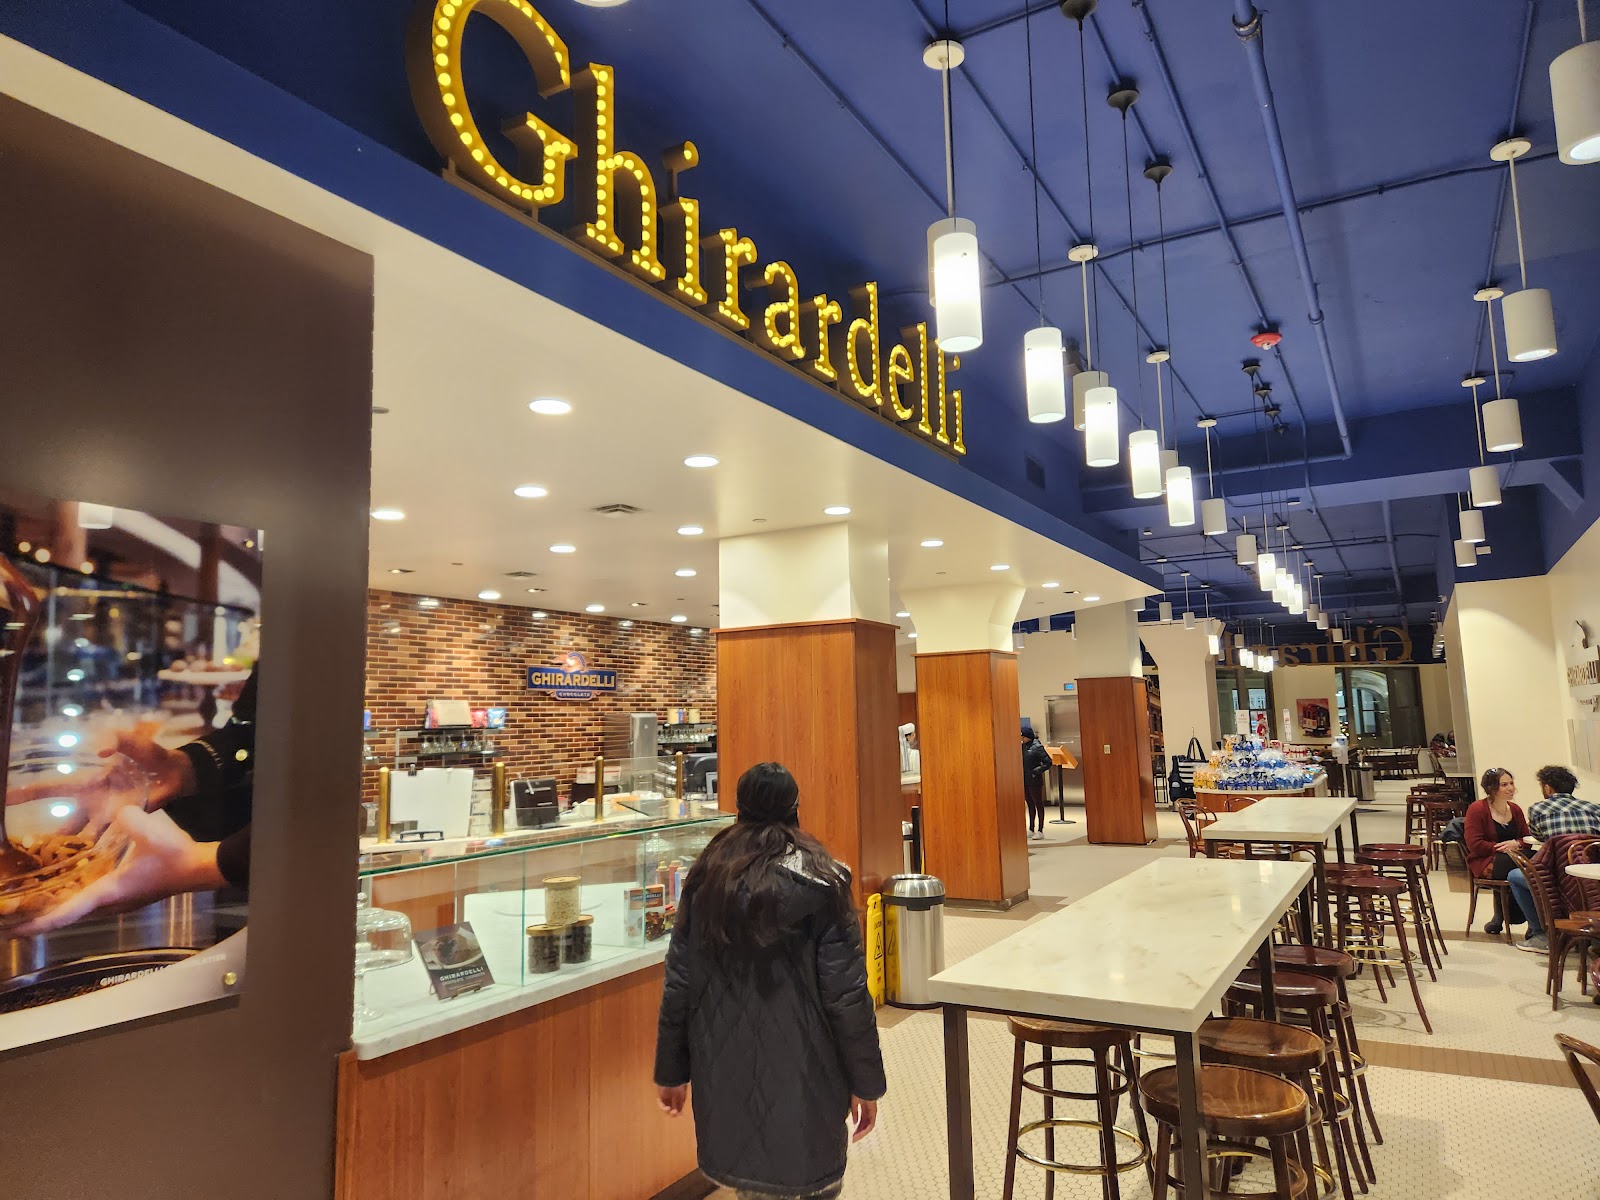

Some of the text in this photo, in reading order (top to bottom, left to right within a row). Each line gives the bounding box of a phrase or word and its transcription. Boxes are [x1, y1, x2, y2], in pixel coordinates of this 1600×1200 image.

[430, 0, 966, 455] Ghirardelli
[531, 672, 615, 687] GHIRARDELLI
[440, 967, 484, 981] GHIRARDELLI
